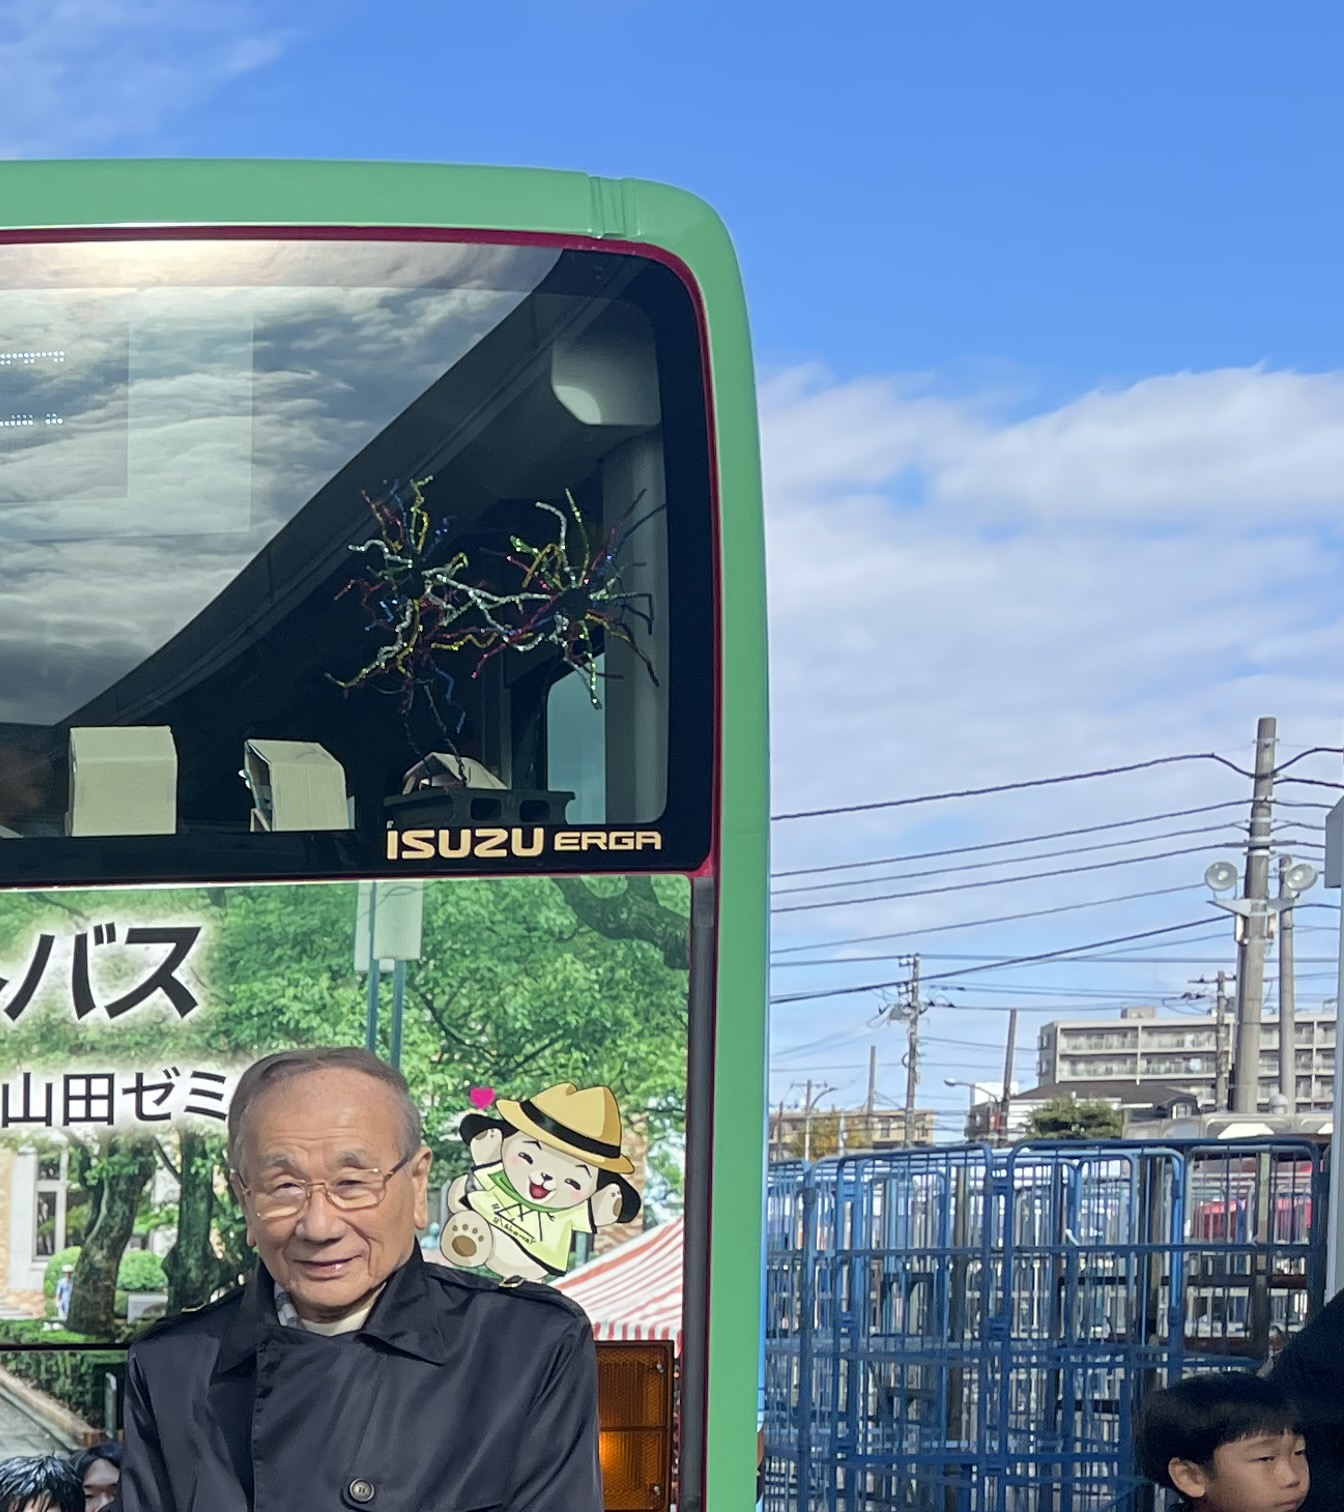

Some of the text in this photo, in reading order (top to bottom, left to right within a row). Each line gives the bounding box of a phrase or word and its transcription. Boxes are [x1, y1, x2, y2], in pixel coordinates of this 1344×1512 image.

[387, 827, 662, 860] ISUZU ERGA
[1, 1066, 229, 1128] 山田ゼミ
